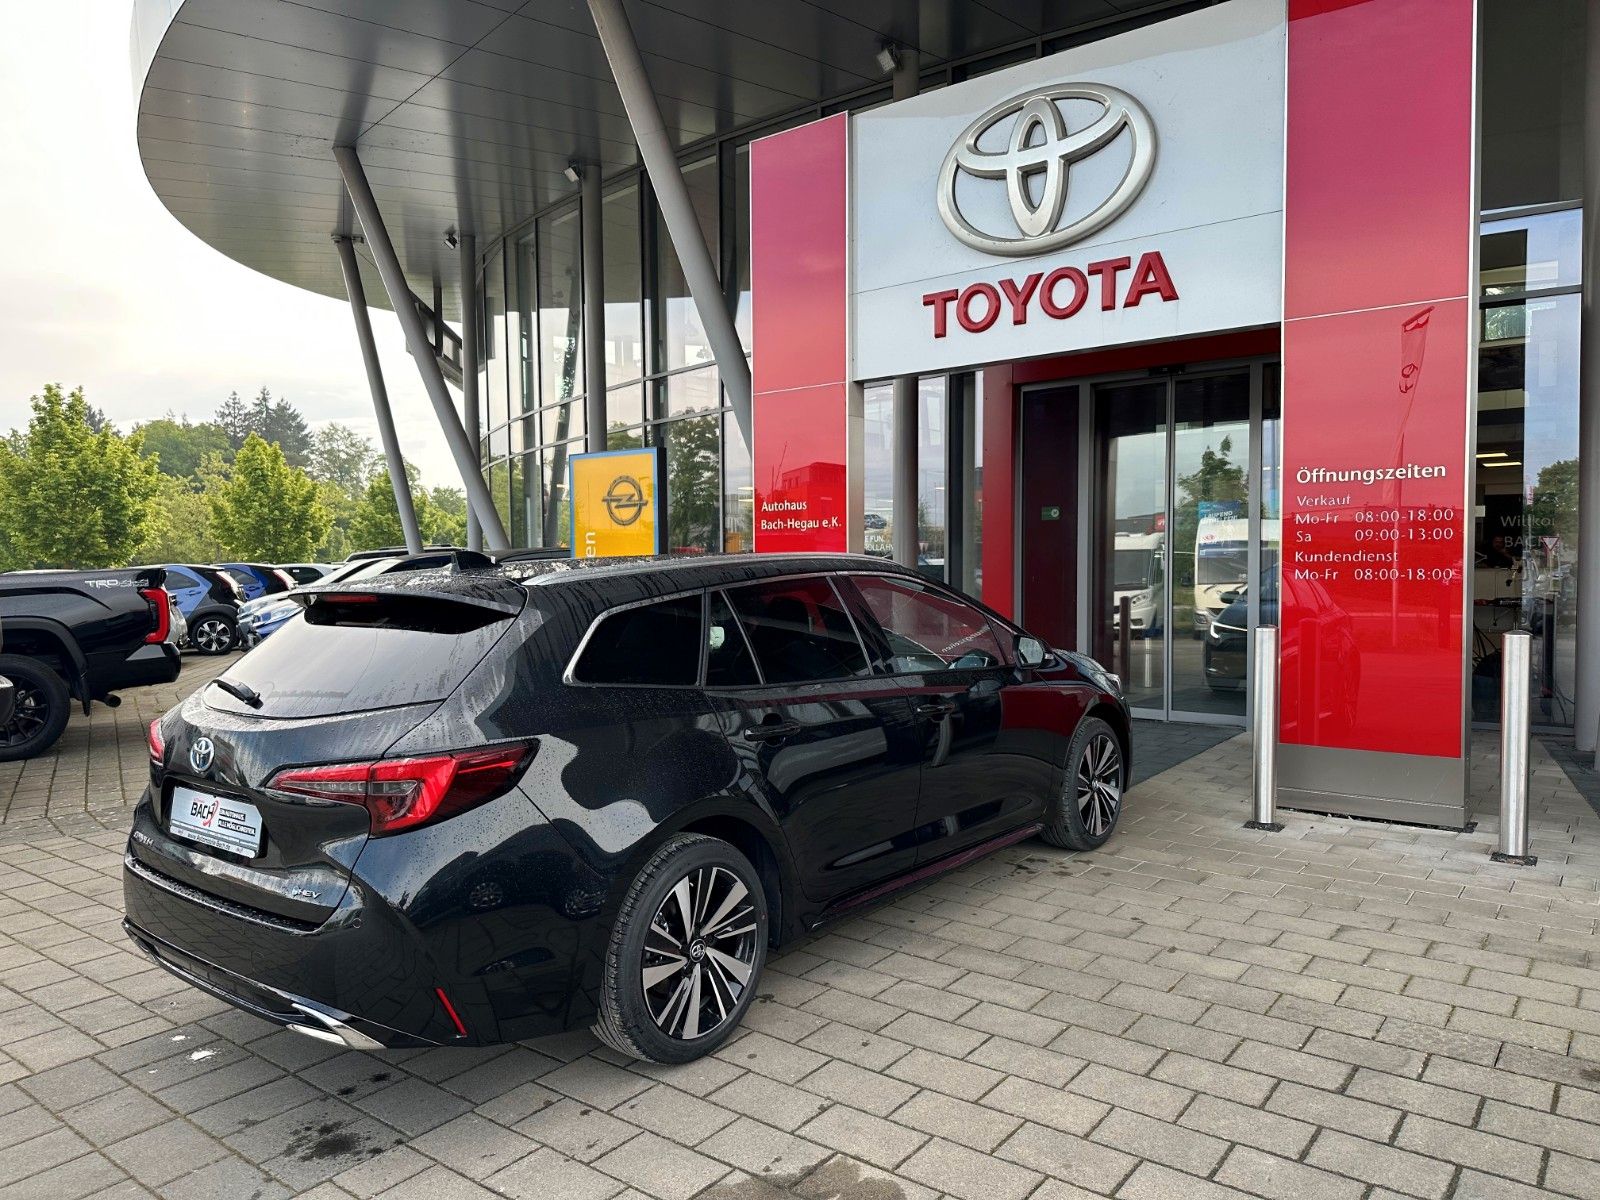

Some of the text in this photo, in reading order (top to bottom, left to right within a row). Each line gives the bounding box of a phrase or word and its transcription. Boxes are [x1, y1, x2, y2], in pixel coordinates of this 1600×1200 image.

[923, 251, 1179, 338] TOYOTA
[1296, 464, 1446, 485] Öffnungszeiten
[761, 500, 807, 512] Autohaus
[1296, 494, 1351, 506] Verkauf
[761, 516, 842, 531] Bach-Hegau e.K.
[1295, 509, 1454, 524] Mo-Fr 08:00-18:00
[1296, 528, 1454, 542] Sa 09:00-13:00
[585, 532, 596, 558] en
[1295, 550, 1399, 562] Kundendienst
[1295, 568, 1453, 581] Mo-Fr 08:00-18:00
[84, 579, 119, 588] TRD
